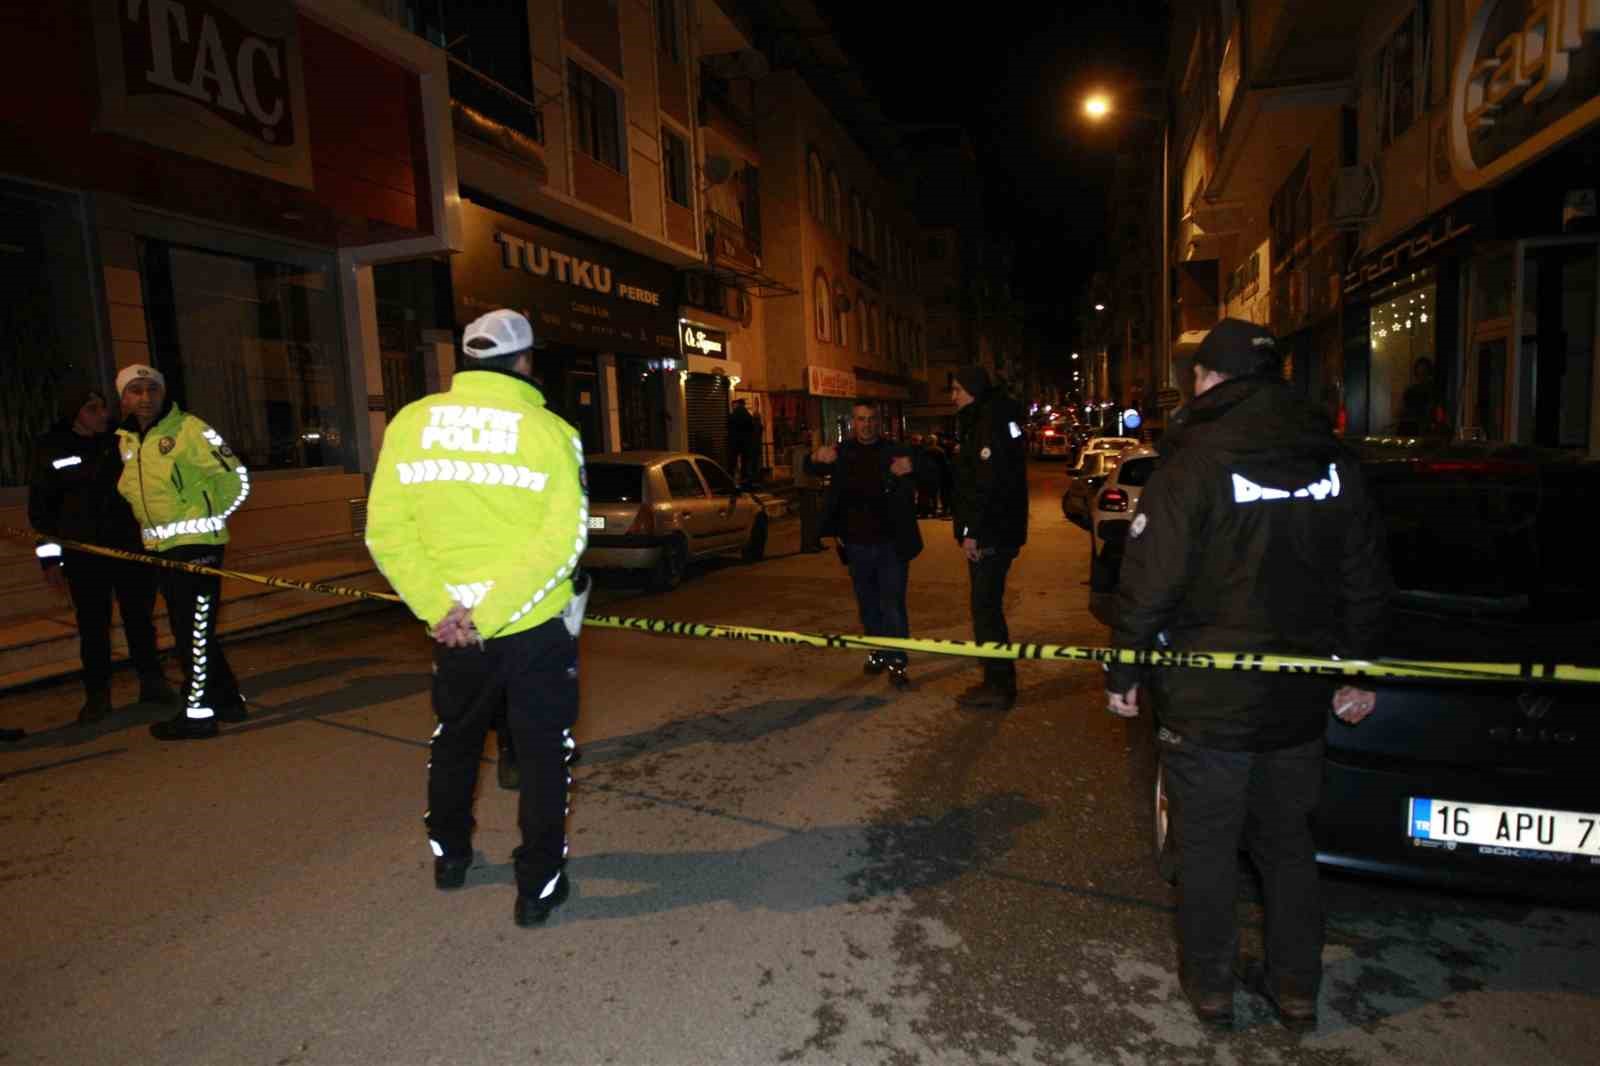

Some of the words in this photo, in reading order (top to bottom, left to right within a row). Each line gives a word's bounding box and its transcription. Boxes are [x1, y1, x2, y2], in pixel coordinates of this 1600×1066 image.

[128, 0, 284, 142] TAÇ
[495, 231, 612, 294] TUTKU
[618, 283, 661, 307] PERDE
[1415, 820, 1430, 832] TR
[1437, 806, 1470, 837] 16
[1496, 812, 1556, 846] APU
[1578, 818, 1600, 848] 7
